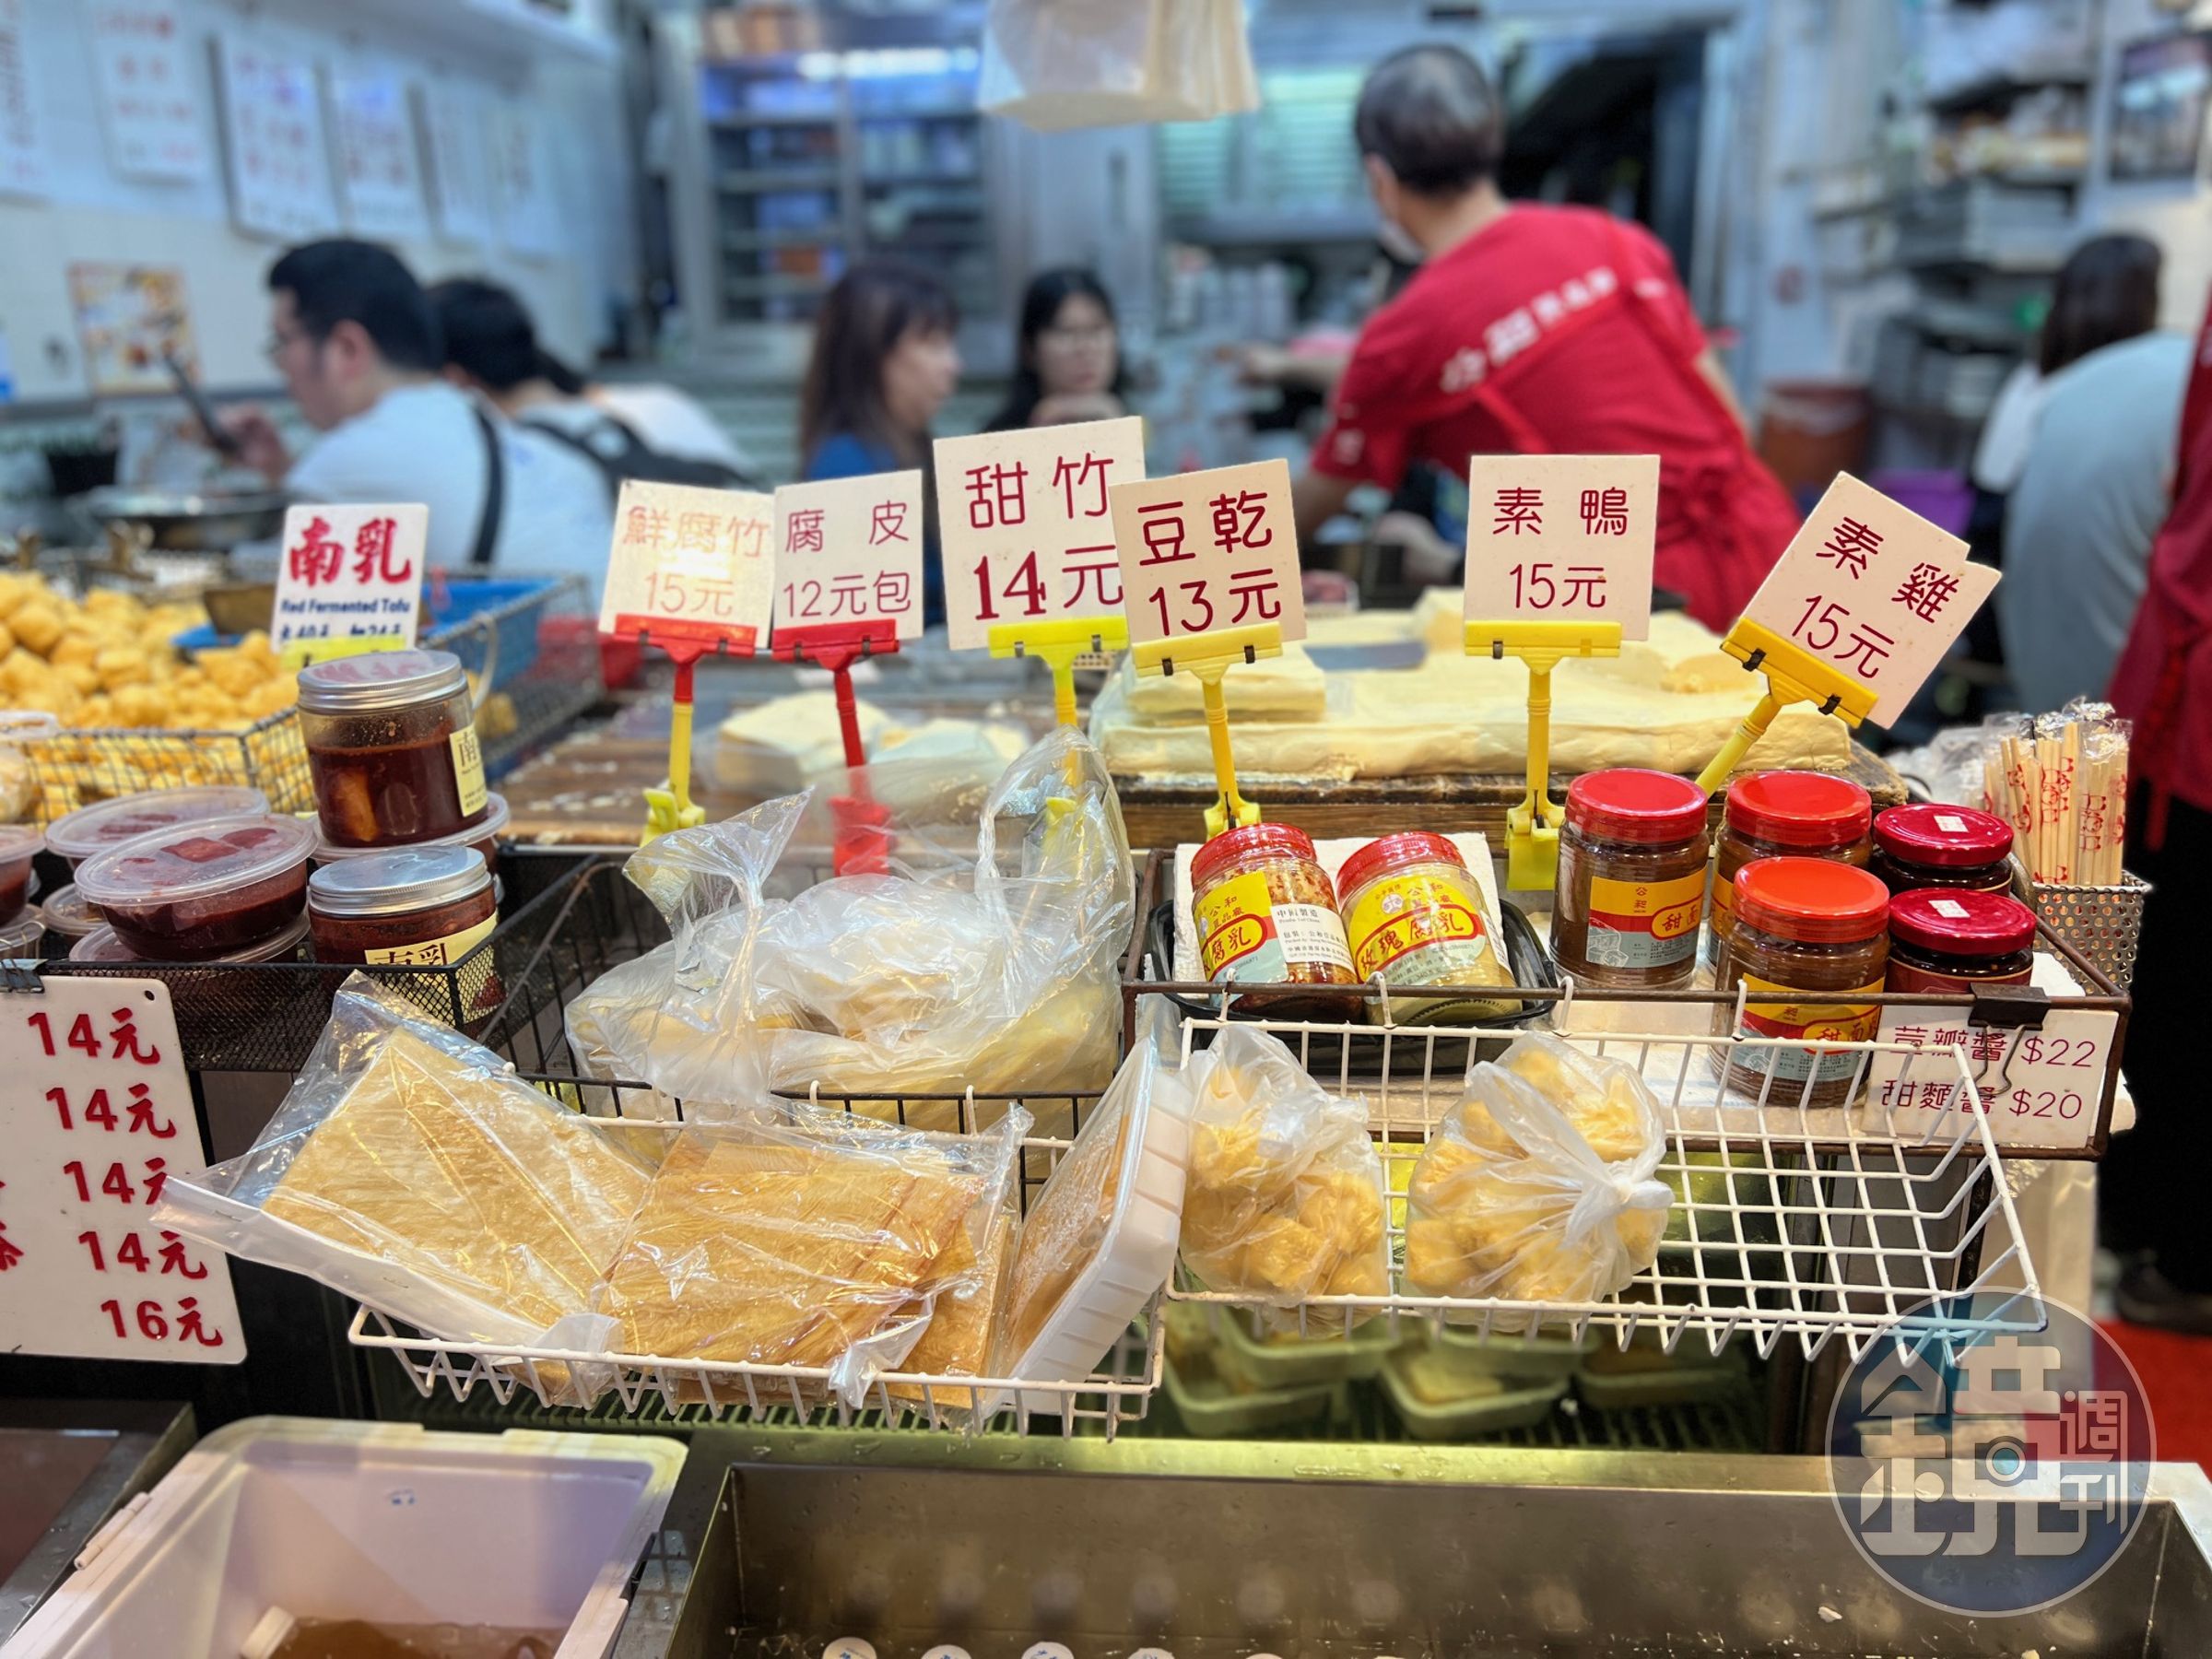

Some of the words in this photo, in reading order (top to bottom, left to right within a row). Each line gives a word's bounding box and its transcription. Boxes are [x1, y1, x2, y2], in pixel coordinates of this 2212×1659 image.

[965, 453, 1114, 529] 甜竹
[1492, 487, 1630, 536] 素鴨
[289, 516, 412, 587] 南乳
[623, 505, 770, 558] 鮮腐竹
[785, 500, 909, 553] 腐皮
[1137, 490, 1273, 566] 豆乾
[644, 571, 735, 617] 15元
[783, 570, 912, 618] 12元包
[973, 544, 1124, 621] 14元
[1508, 563, 1607, 610] 15元
[1816, 516, 1959, 624] 素雞
[281, 599, 305, 613] Red
[309, 598, 378, 613] Fermented
[382, 597, 410, 613] Tofu
[1149, 568, 1281, 636] 13元
[1791, 594, 1896, 679] 15元
[1204, 925, 1252, 972] 腐乳
[28, 1007, 161, 1065] 14元
[2020, 1035, 2096, 1069] $22
[45, 1083, 178, 1138] 14元
[2008, 1088, 2082, 1120] $20
[78, 1230, 208, 1280] 14元
[100, 1296, 224, 1347] 16元
